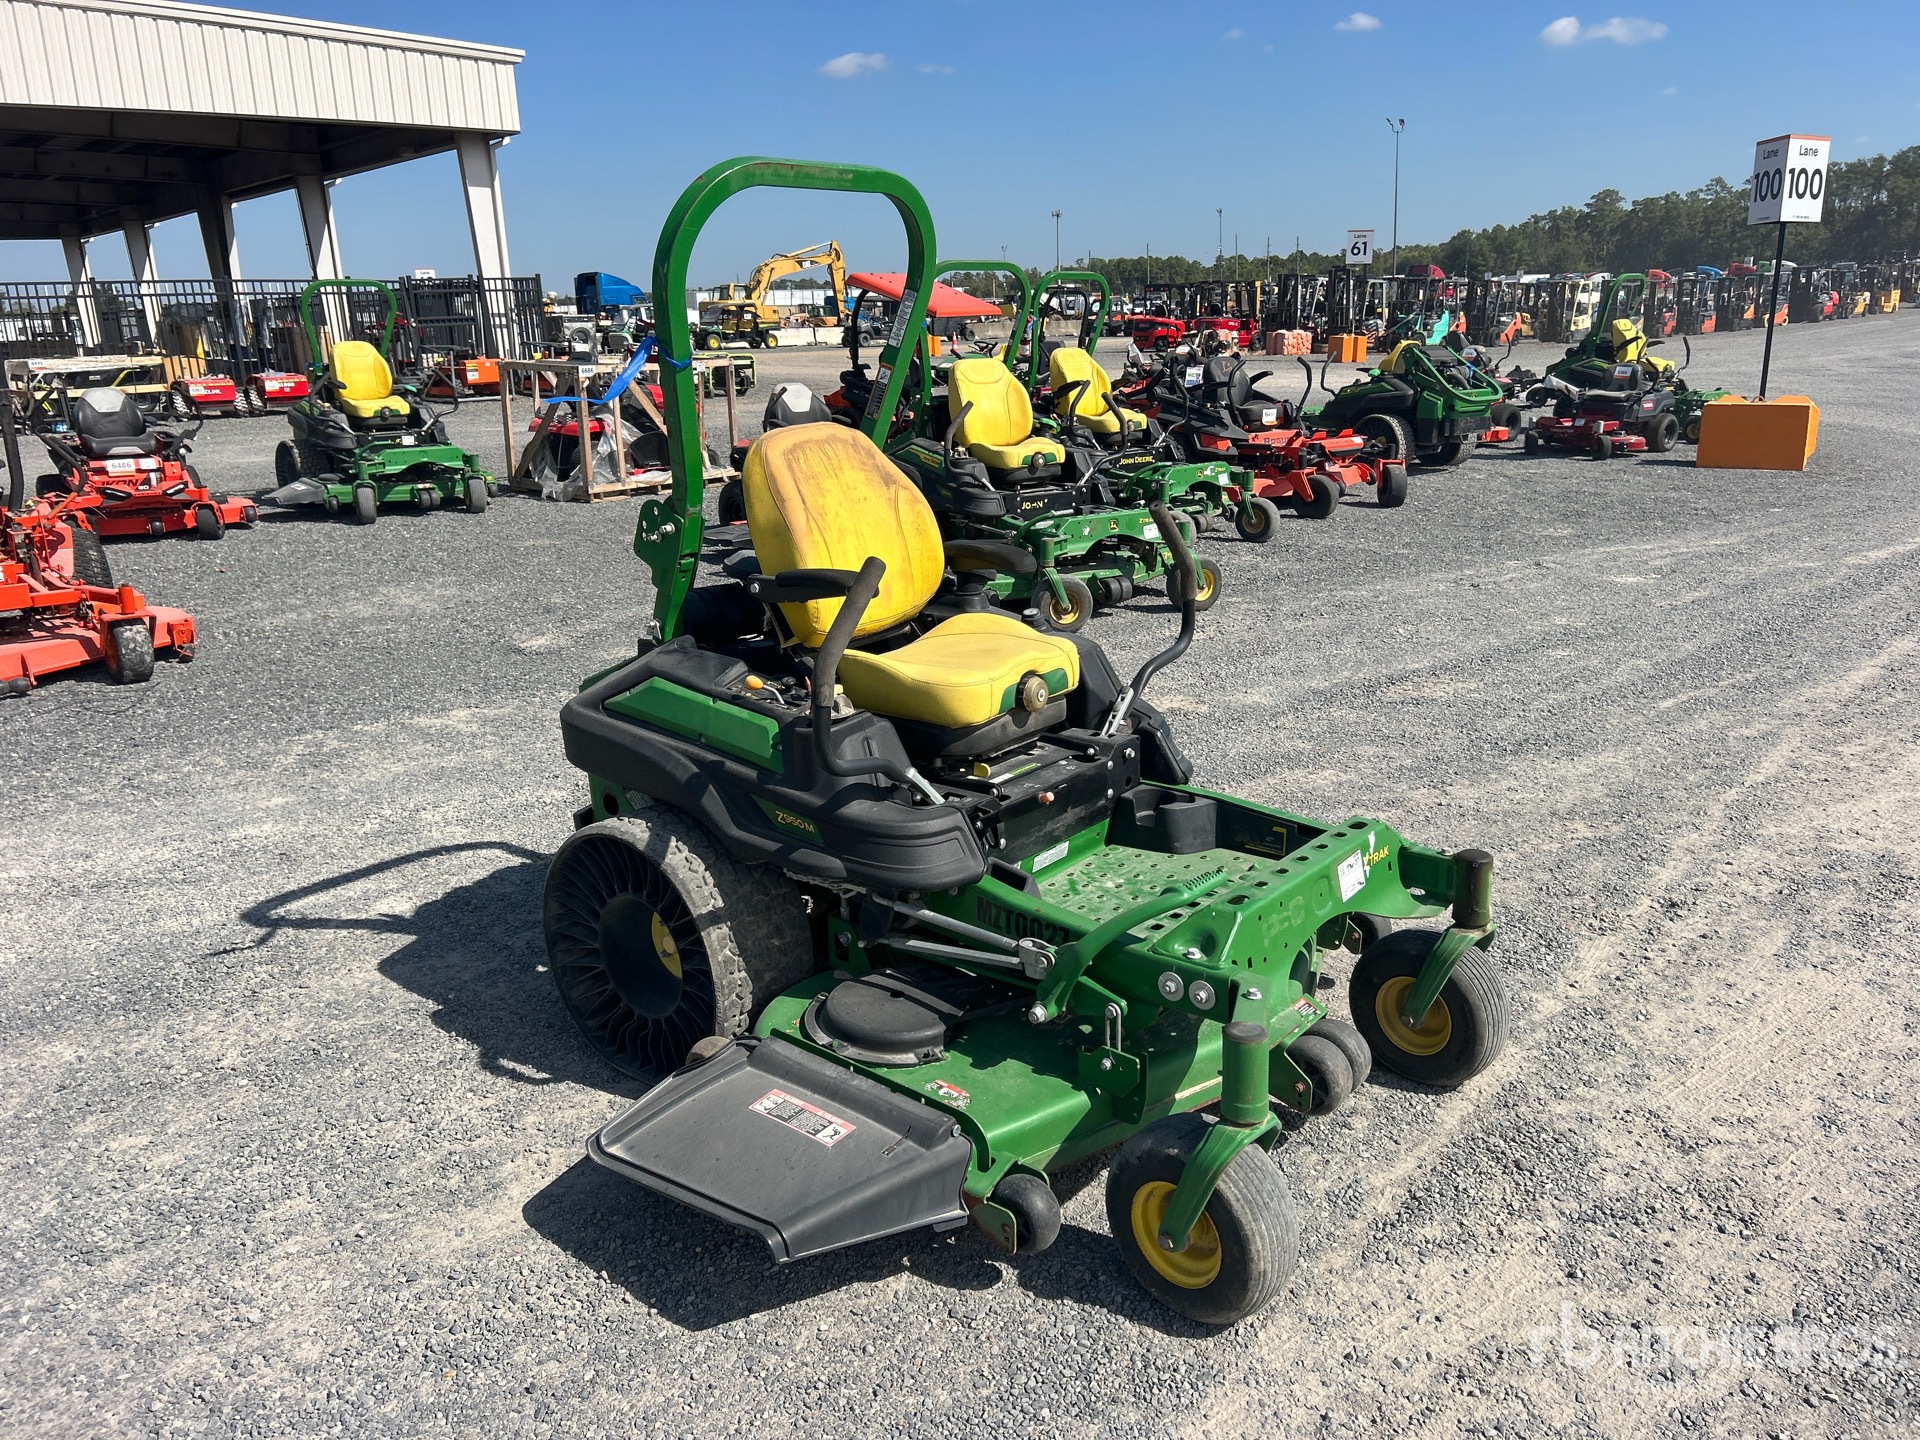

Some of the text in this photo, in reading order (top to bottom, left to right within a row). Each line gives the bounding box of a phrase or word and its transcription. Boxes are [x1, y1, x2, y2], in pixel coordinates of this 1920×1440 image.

[1763, 148, 1779, 160] Lane
[1799, 144, 1819, 157] Lane
[1753, 167, 1783, 203] 100
[1788, 167, 1823, 200] 100
[1350, 241, 1368, 256] 61
[1263, 436, 1291, 446] ROGU
[111, 461, 132, 469] 6486
[775, 810, 815, 833] Z950M
